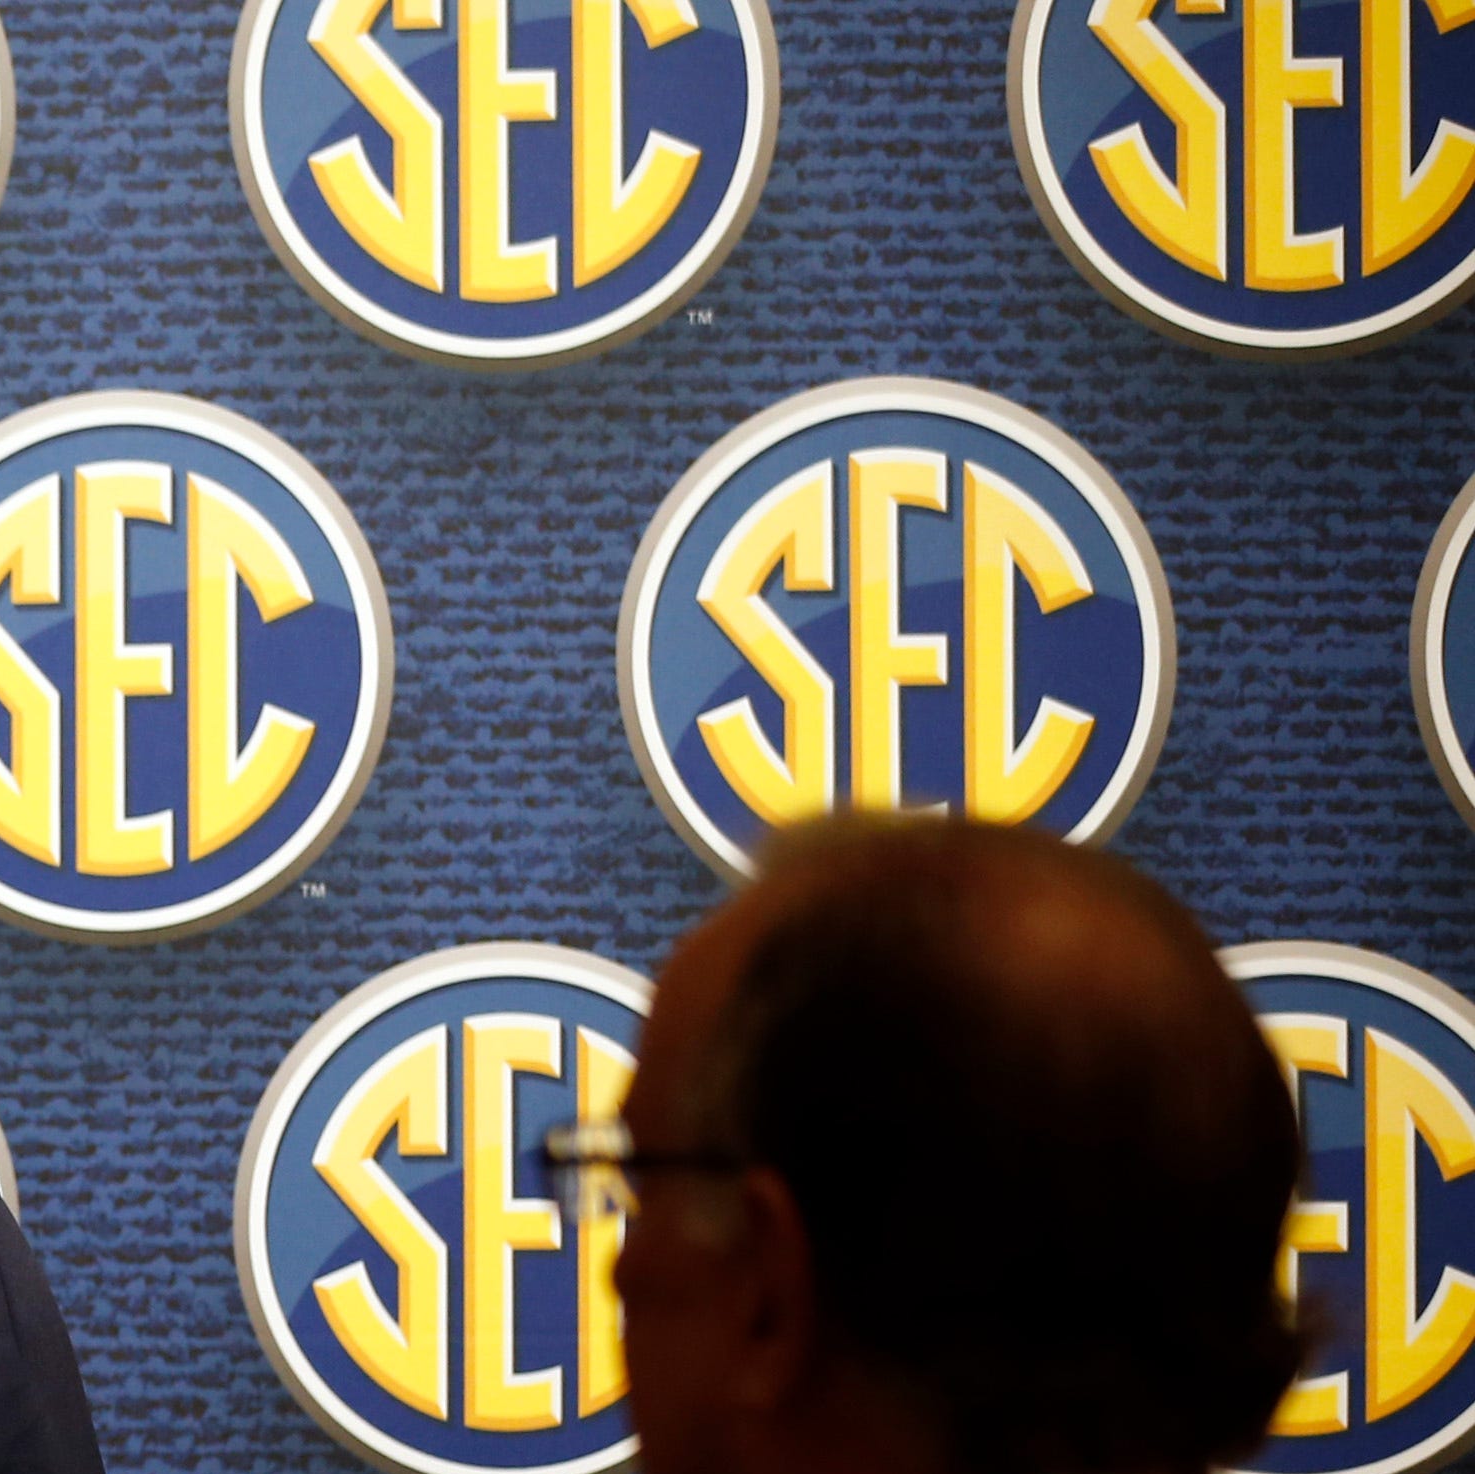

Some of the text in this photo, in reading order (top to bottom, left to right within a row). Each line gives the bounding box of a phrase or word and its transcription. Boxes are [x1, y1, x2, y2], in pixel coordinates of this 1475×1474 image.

[307, 0, 703, 303] SEC
[1087, 0, 1475, 292] SEC
[687, 308, 713, 326] TM
[696, 445, 1095, 836] SEC
[300, 881, 327, 899] TM
